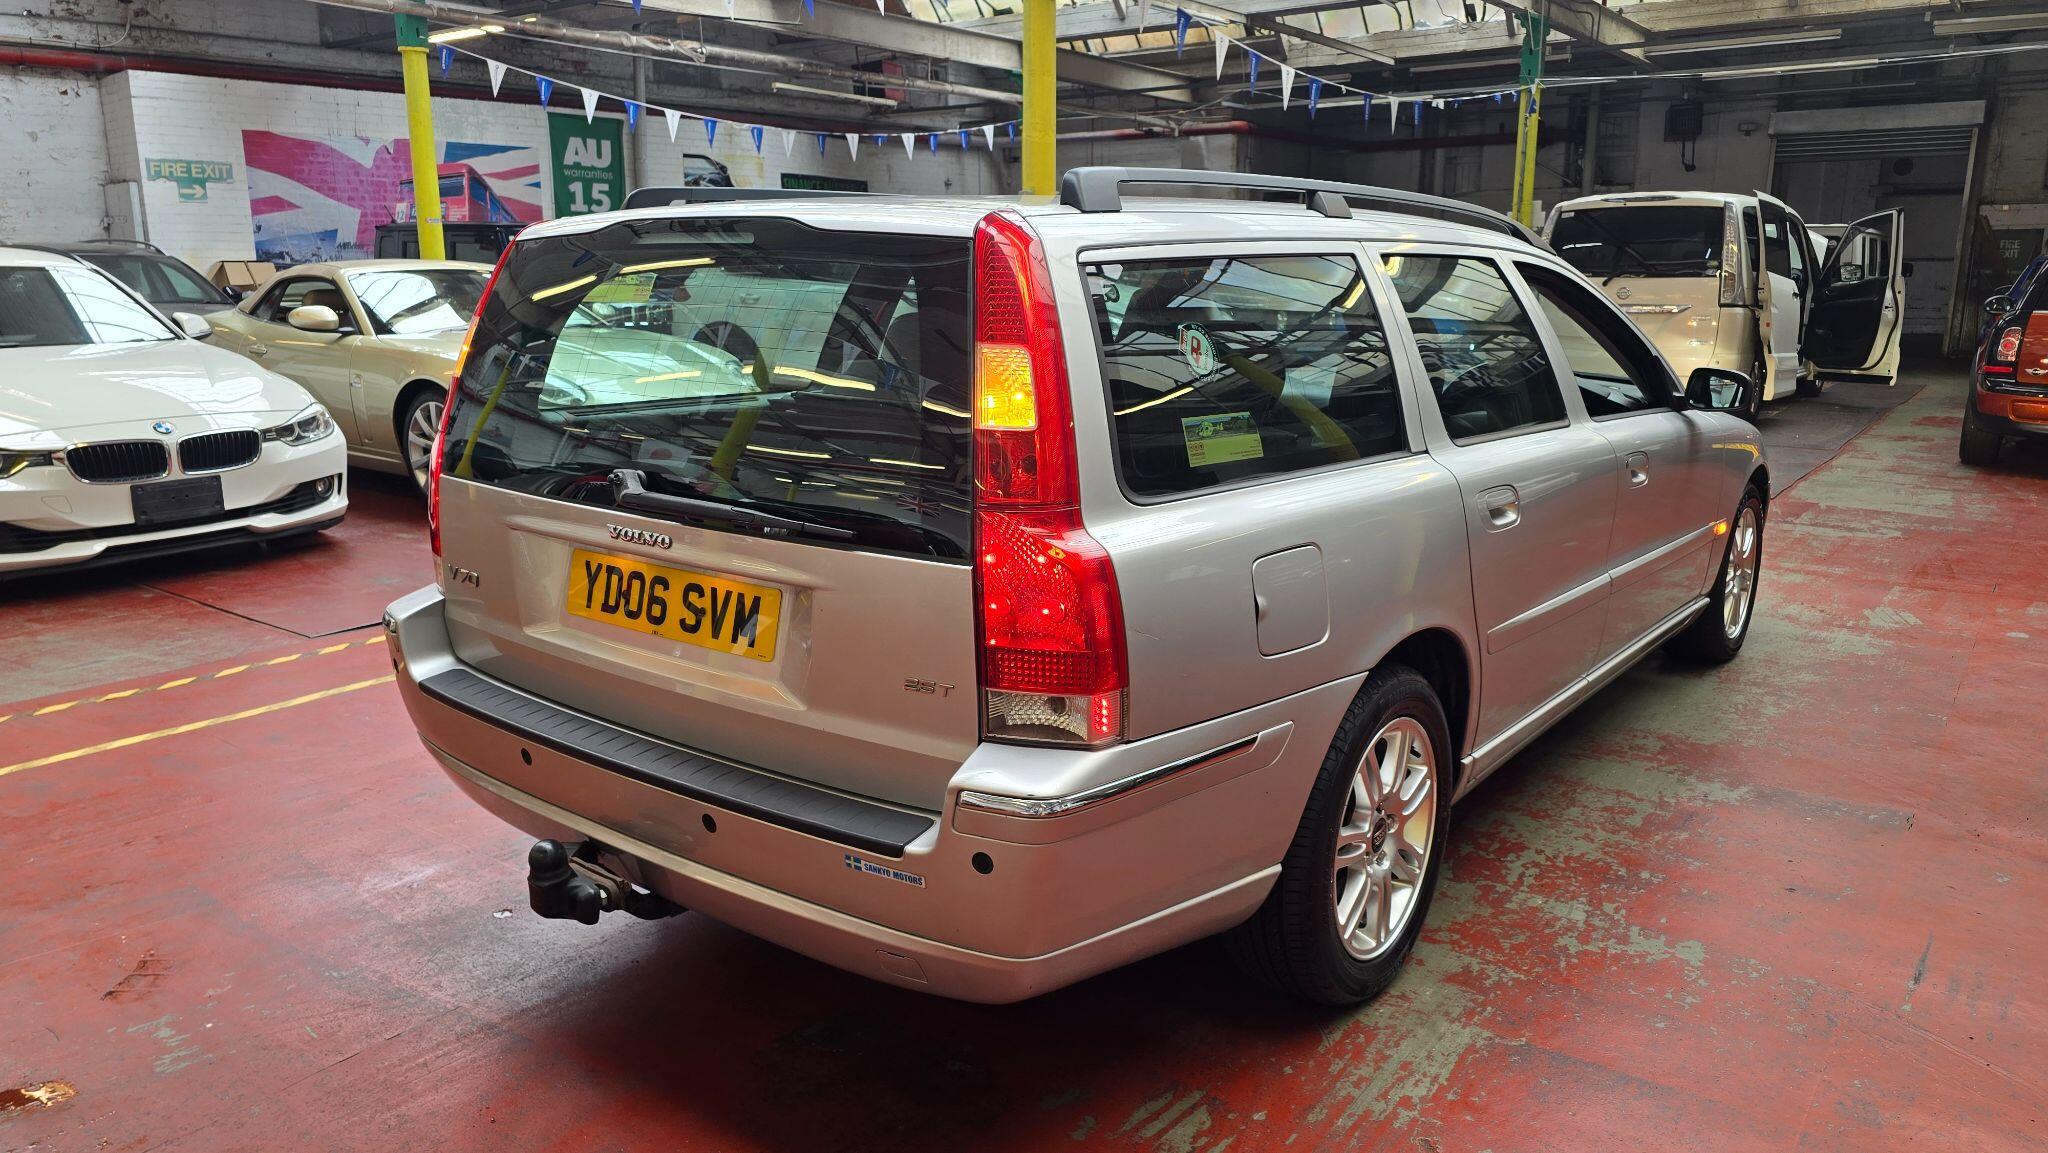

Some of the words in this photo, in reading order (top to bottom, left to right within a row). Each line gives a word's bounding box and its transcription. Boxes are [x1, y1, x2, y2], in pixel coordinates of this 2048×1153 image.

[563, 136, 612, 168] AU
[149, 161, 189, 177] FIRE
[191, 163, 230, 178] EXIT
[563, 167, 614, 180] warranties
[568, 181, 612, 213] 15
[2000, 239, 2022, 249] FIRE
[606, 523, 673, 549] VOLVO
[448, 563, 480, 588] V70
[585, 560, 670, 626] YD06
[679, 582, 762, 648] SVM
[864, 863, 891, 878] SANKYO
[892, 870, 923, 886] MOTORS
